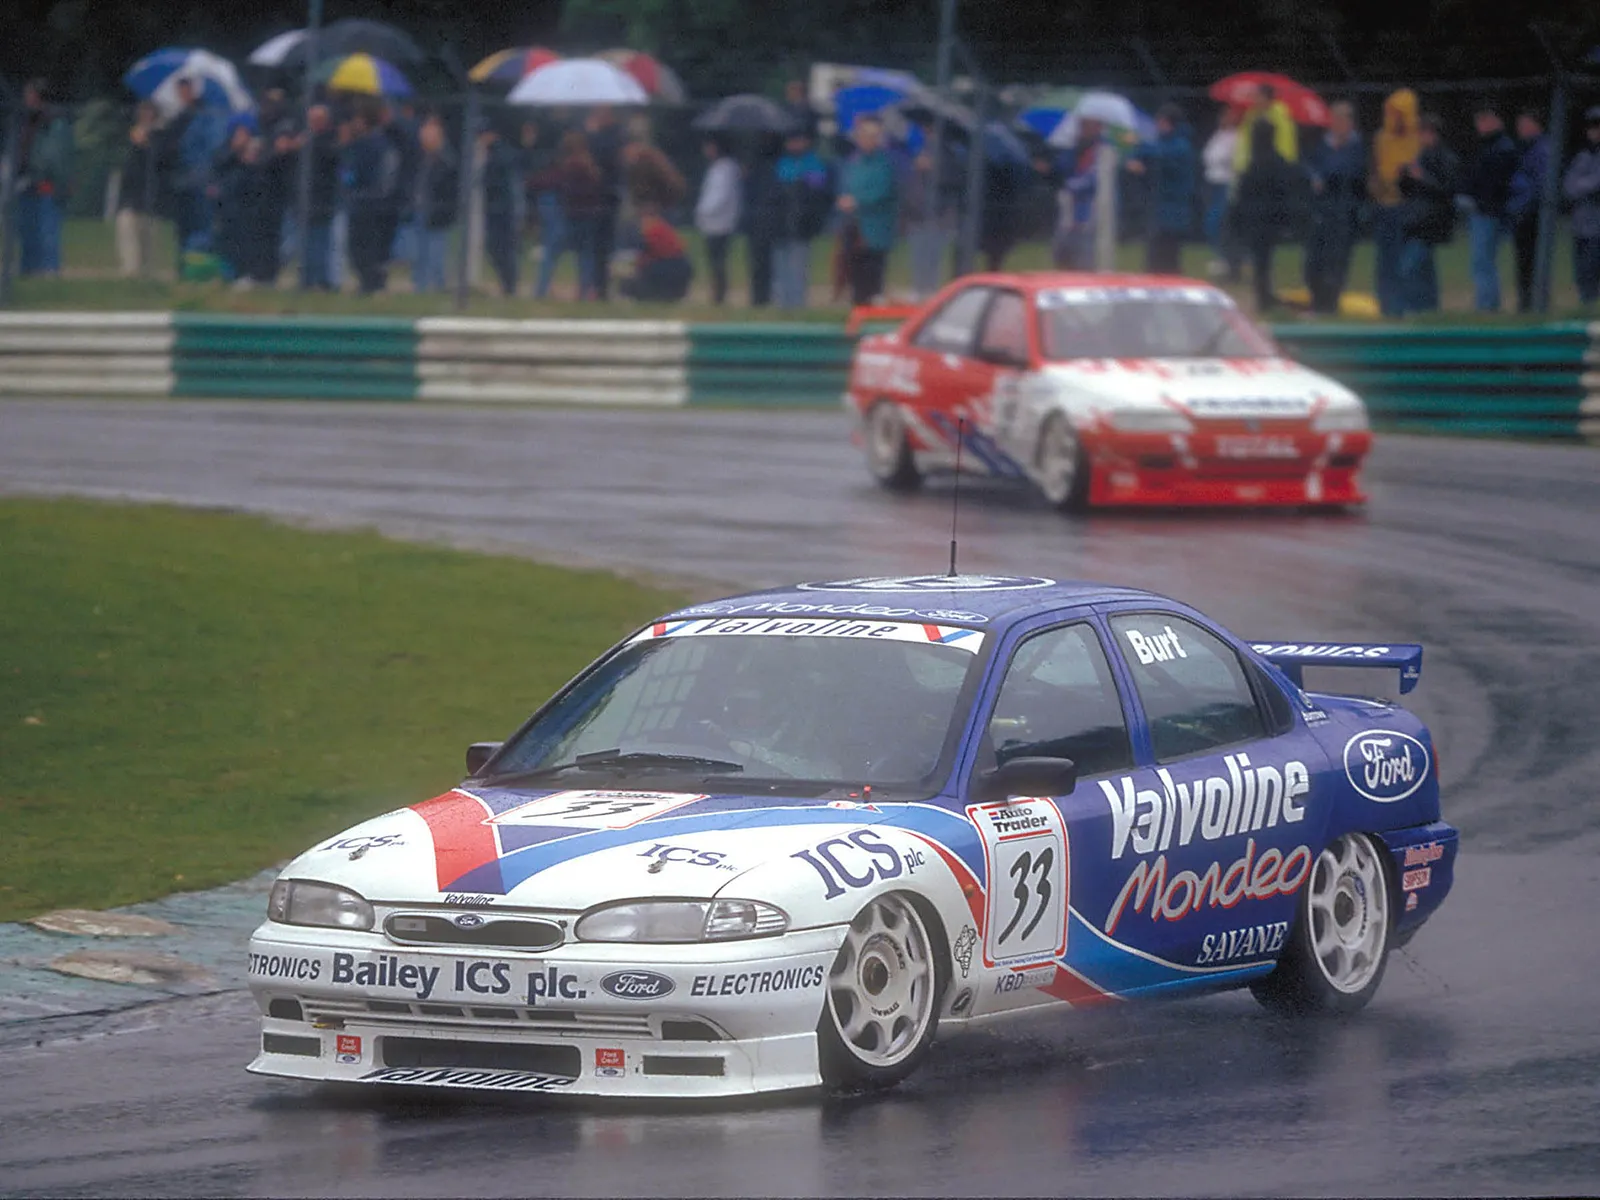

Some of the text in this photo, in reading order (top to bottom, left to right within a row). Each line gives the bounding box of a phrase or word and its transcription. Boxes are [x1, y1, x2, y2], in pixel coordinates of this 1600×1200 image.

[695, 617, 898, 637] Valvoline
[1126, 626, 1188, 665] Burt
[1360, 738, 1415, 789] Ford
[993, 815, 1049, 833] Trader
[998, 807, 1033, 820] Auto
[1098, 753, 1310, 860] Valvoline
[636, 843, 728, 866] ICS
[789, 829, 926, 900] ICS plc
[443, 893, 496, 905] Valvoline
[998, 847, 1054, 946] 33
[1105, 838, 1313, 938] Mondeo
[1196, 921, 1288, 963] SAVANE
[332, 952, 587, 1005] Bailey ICS plc.
[613, 971, 660, 996] Ford
[690, 965, 824, 997] ELECTRONICS
[994, 973, 1024, 995] KBD
